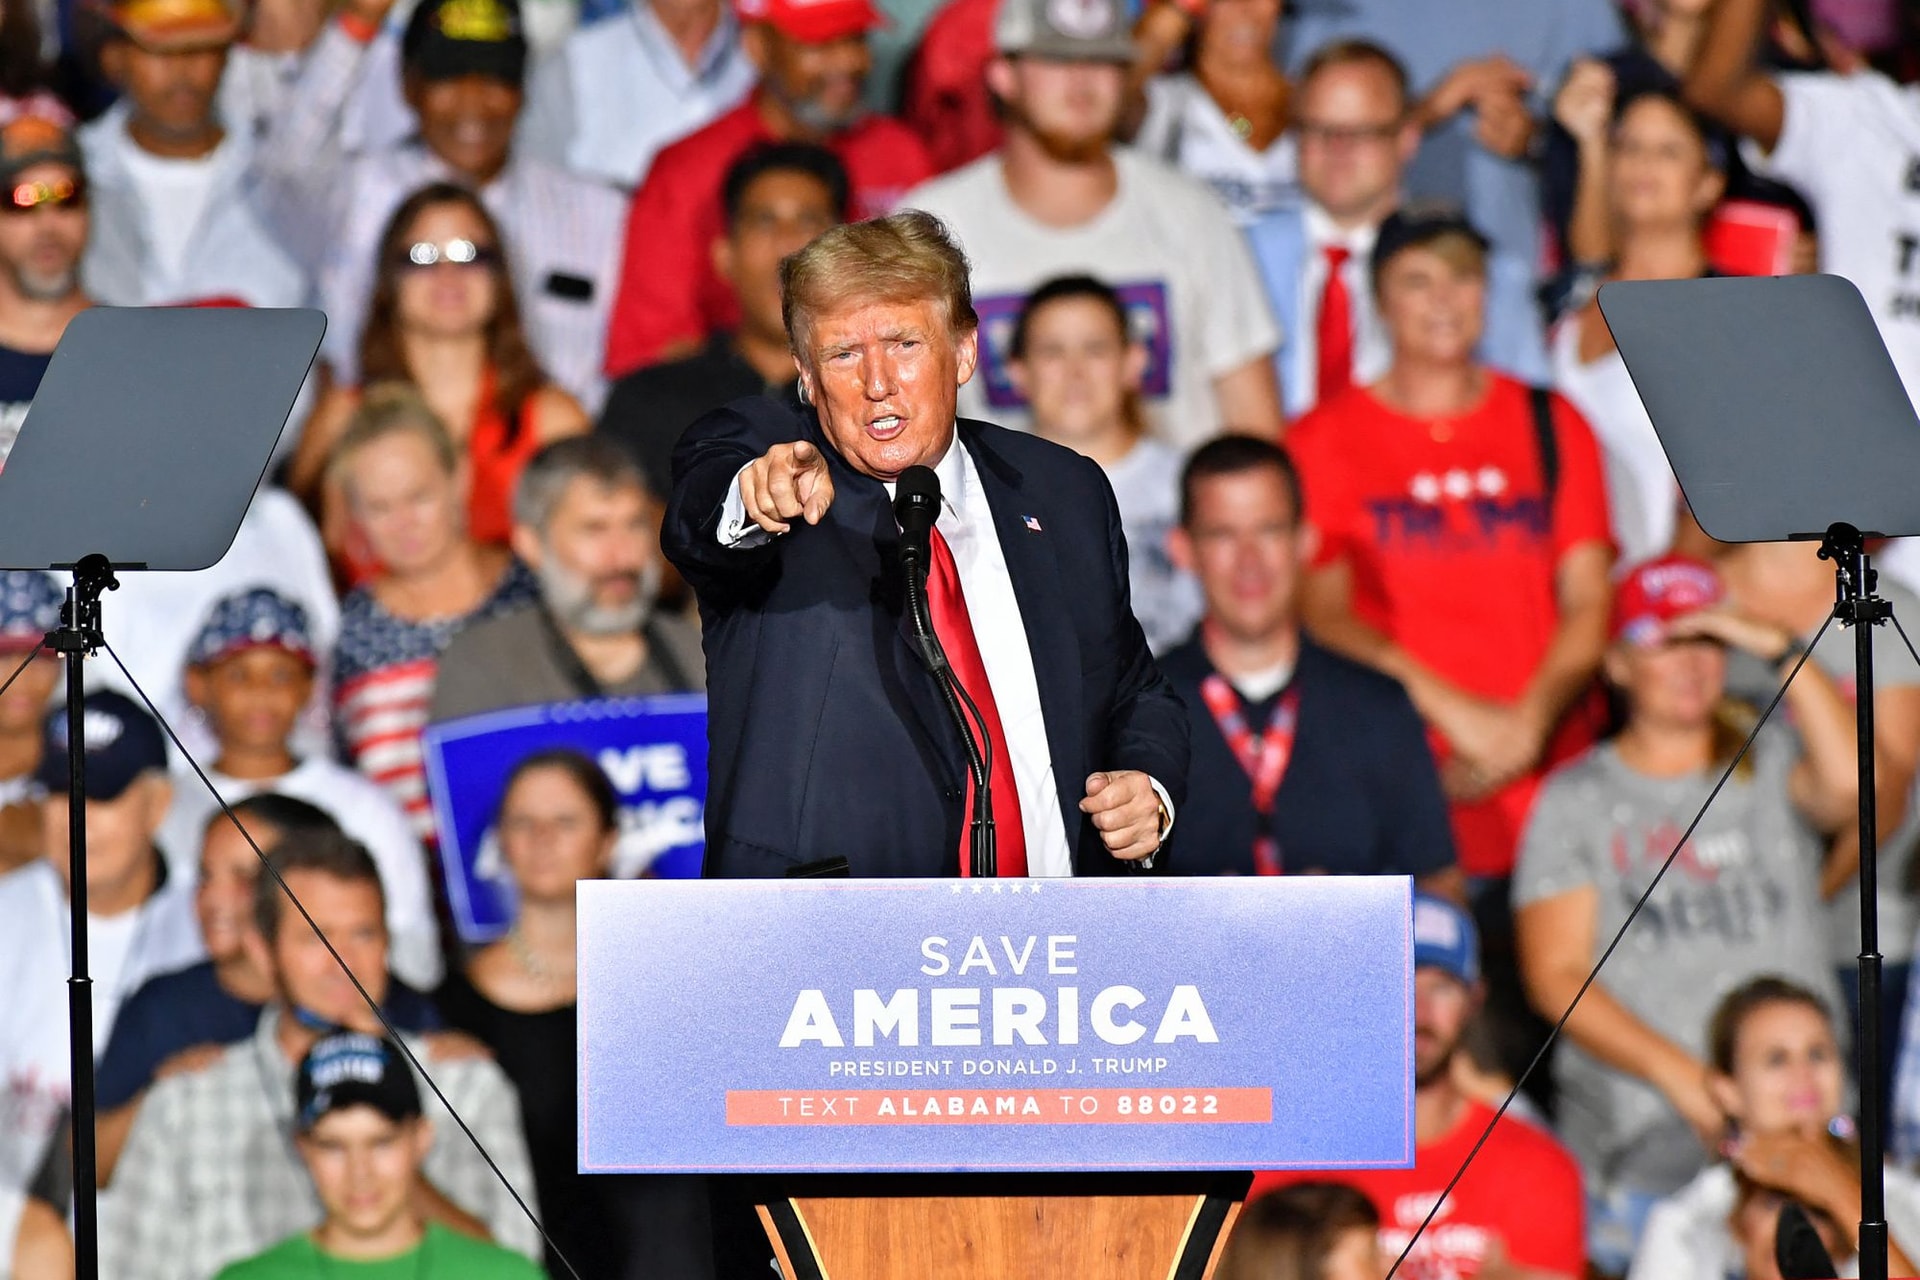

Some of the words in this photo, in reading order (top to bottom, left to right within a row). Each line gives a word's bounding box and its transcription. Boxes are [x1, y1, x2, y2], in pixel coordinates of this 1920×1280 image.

[920, 935, 1078, 976] SAVE
[778, 984, 1220, 1048] AMERICA
[829, 1060, 953, 1077] PRESIDENT
[963, 1058, 1057, 1076] DONALD
[1066, 1058, 1083, 1074] J.
[1092, 1057, 1168, 1074] TRUMP
[778, 1097, 859, 1117] TEXT
[877, 1096, 1041, 1116] ALABAMA
[1060, 1096, 1099, 1115] TO
[1117, 1094, 1219, 1114] 88022
